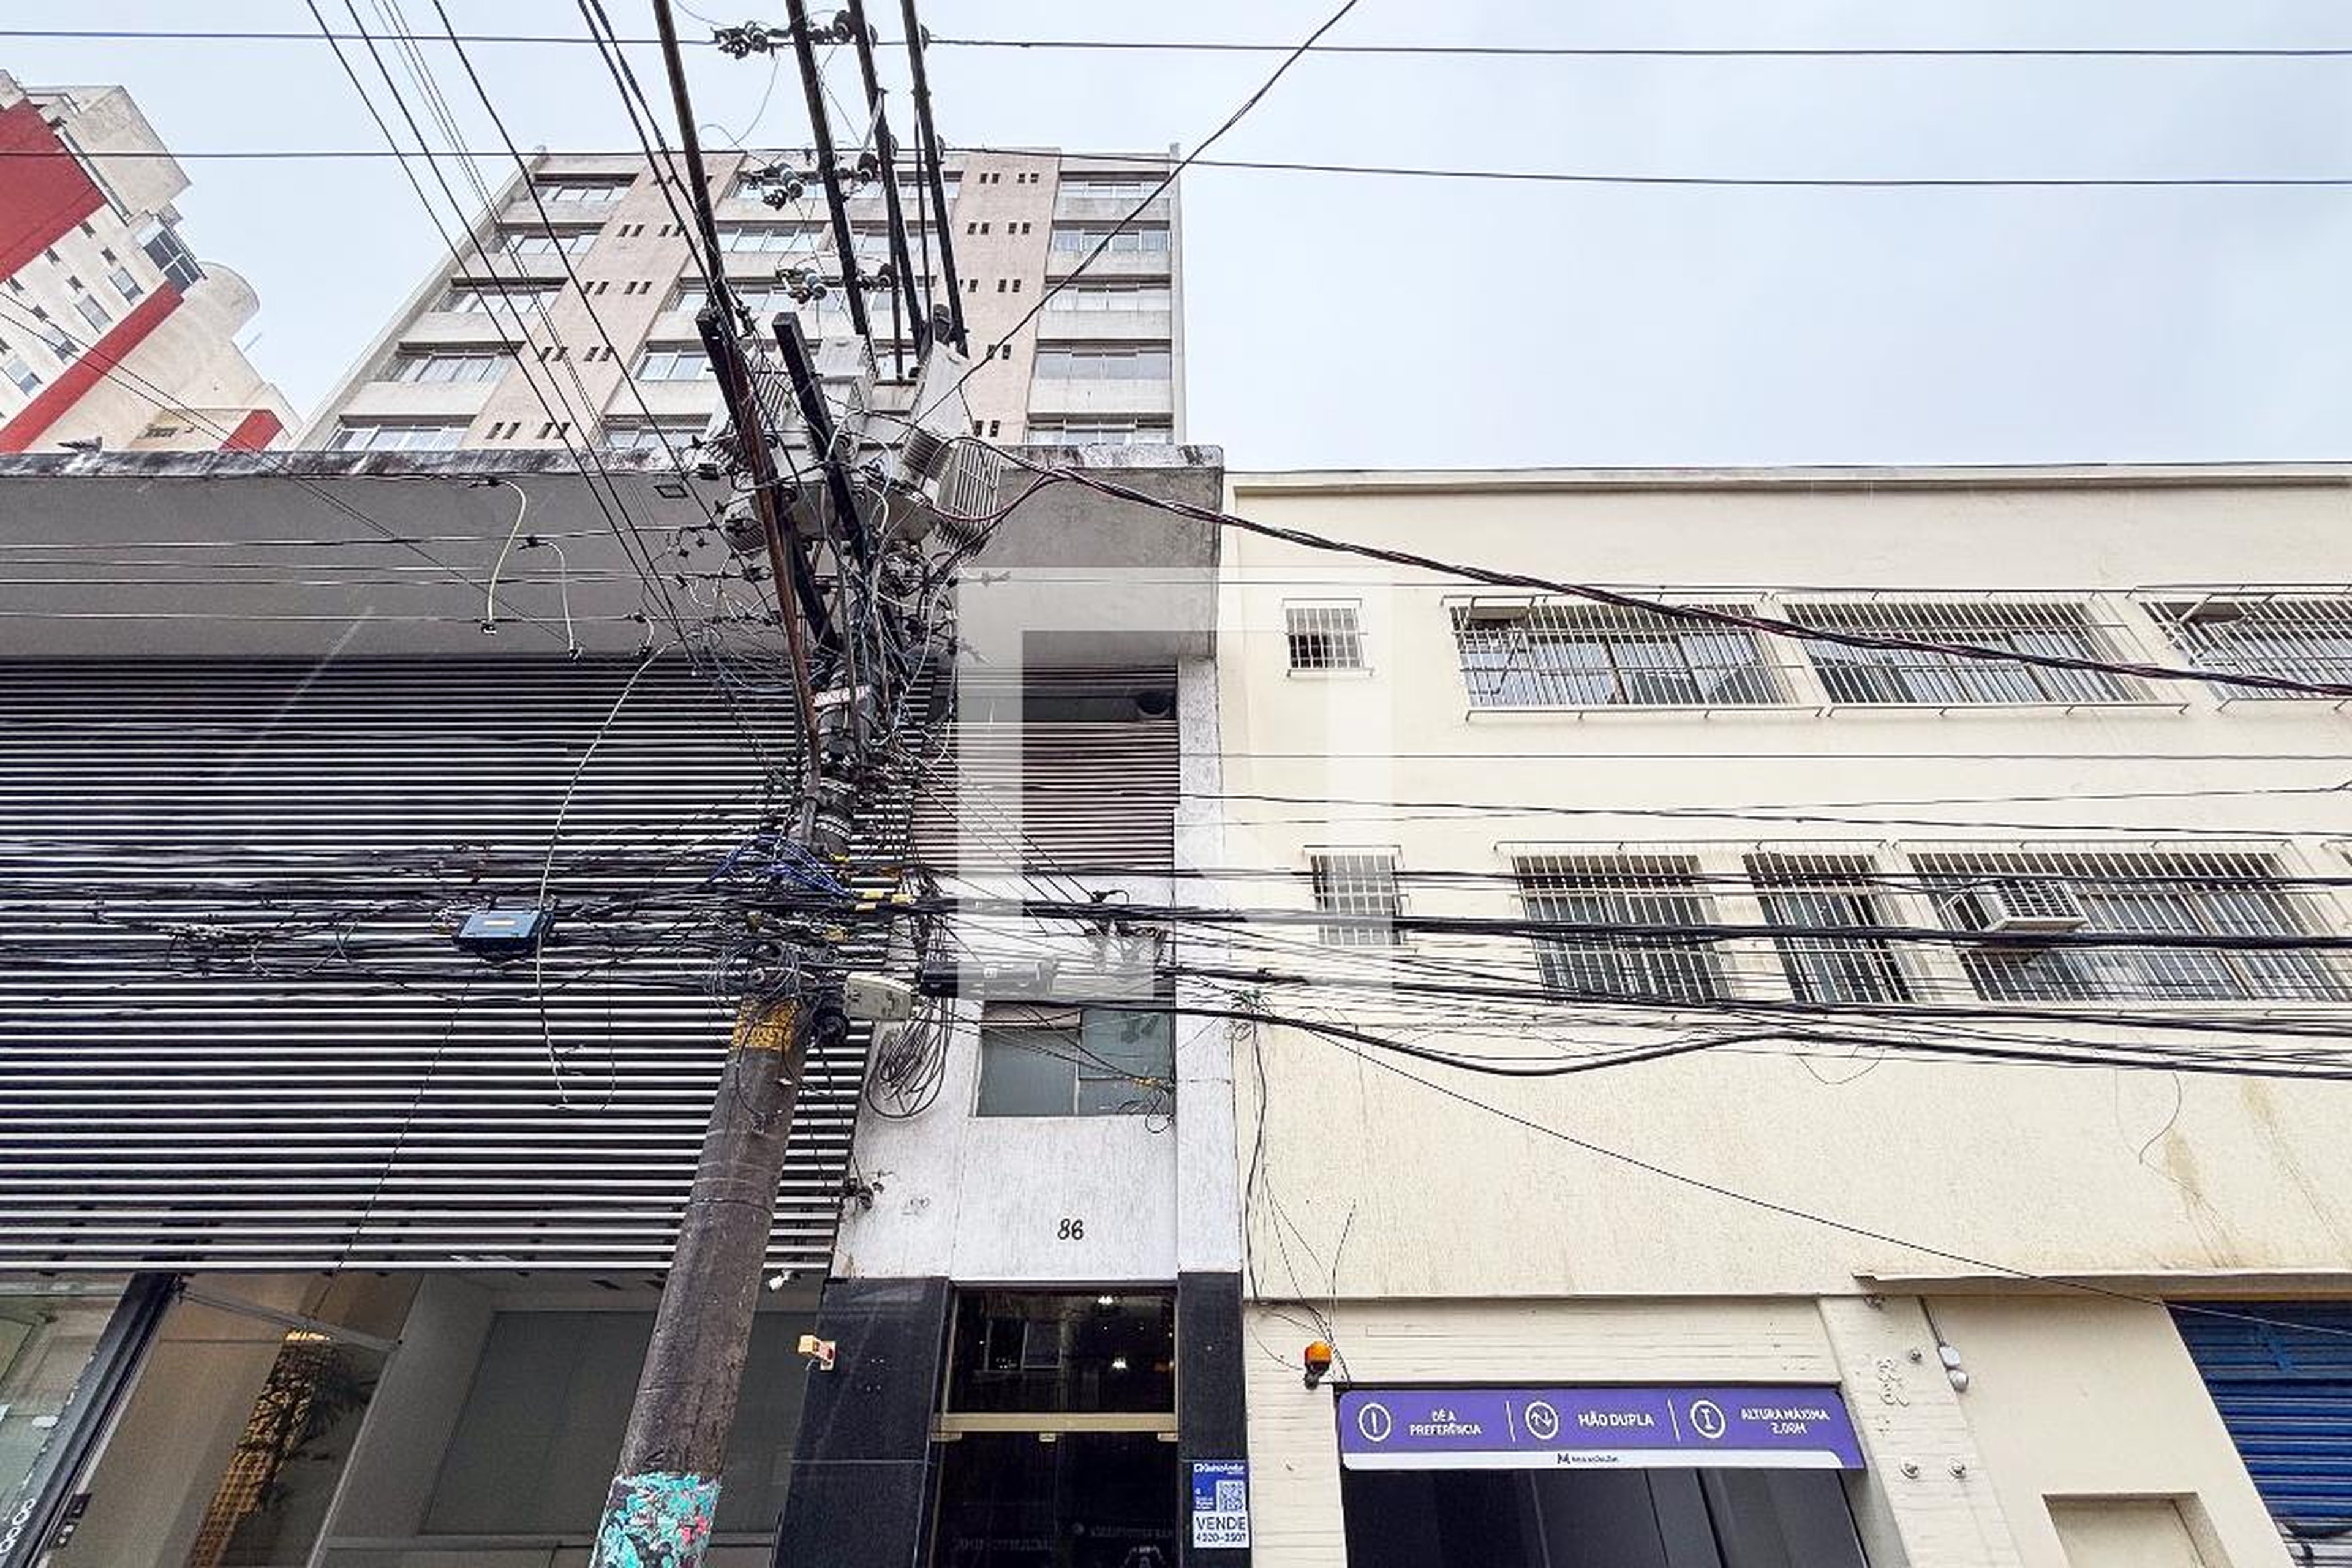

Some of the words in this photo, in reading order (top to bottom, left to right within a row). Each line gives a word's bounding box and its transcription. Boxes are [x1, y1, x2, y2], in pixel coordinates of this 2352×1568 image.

[1057, 1218, 1084, 1240] 86
[1578, 1410, 1608, 1427] MÃO
[1610, 1413, 1654, 1427] DUPLA
[1196, 1516, 1246, 1530] VENDE
